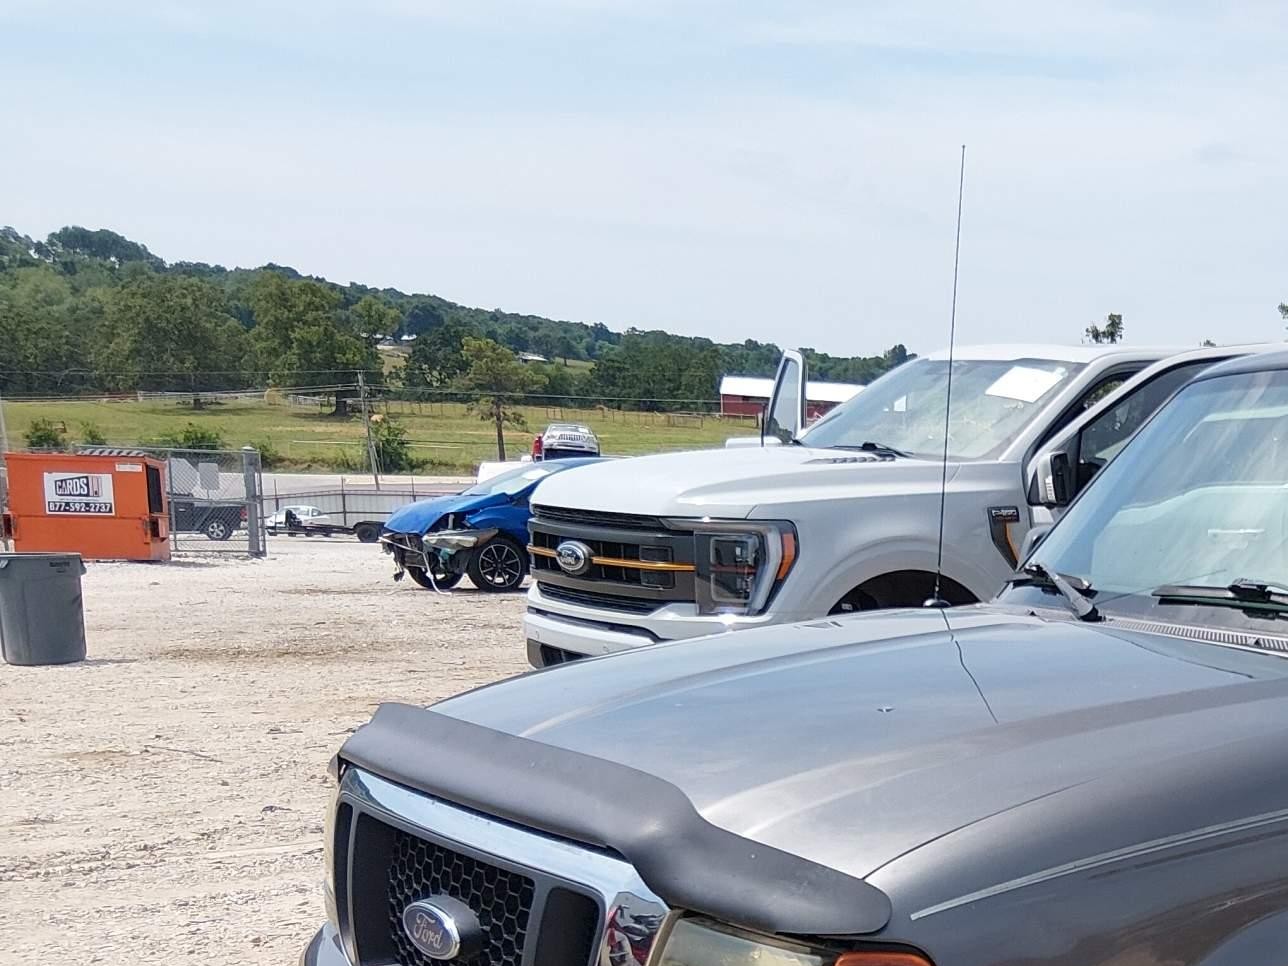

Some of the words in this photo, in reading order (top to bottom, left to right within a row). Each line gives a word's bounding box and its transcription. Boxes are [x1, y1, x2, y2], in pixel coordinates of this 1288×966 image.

[56, 478, 88, 495] CARDS
[49, 502, 111, 512] 877-592-2737
[414, 912, 443, 949] Ford
